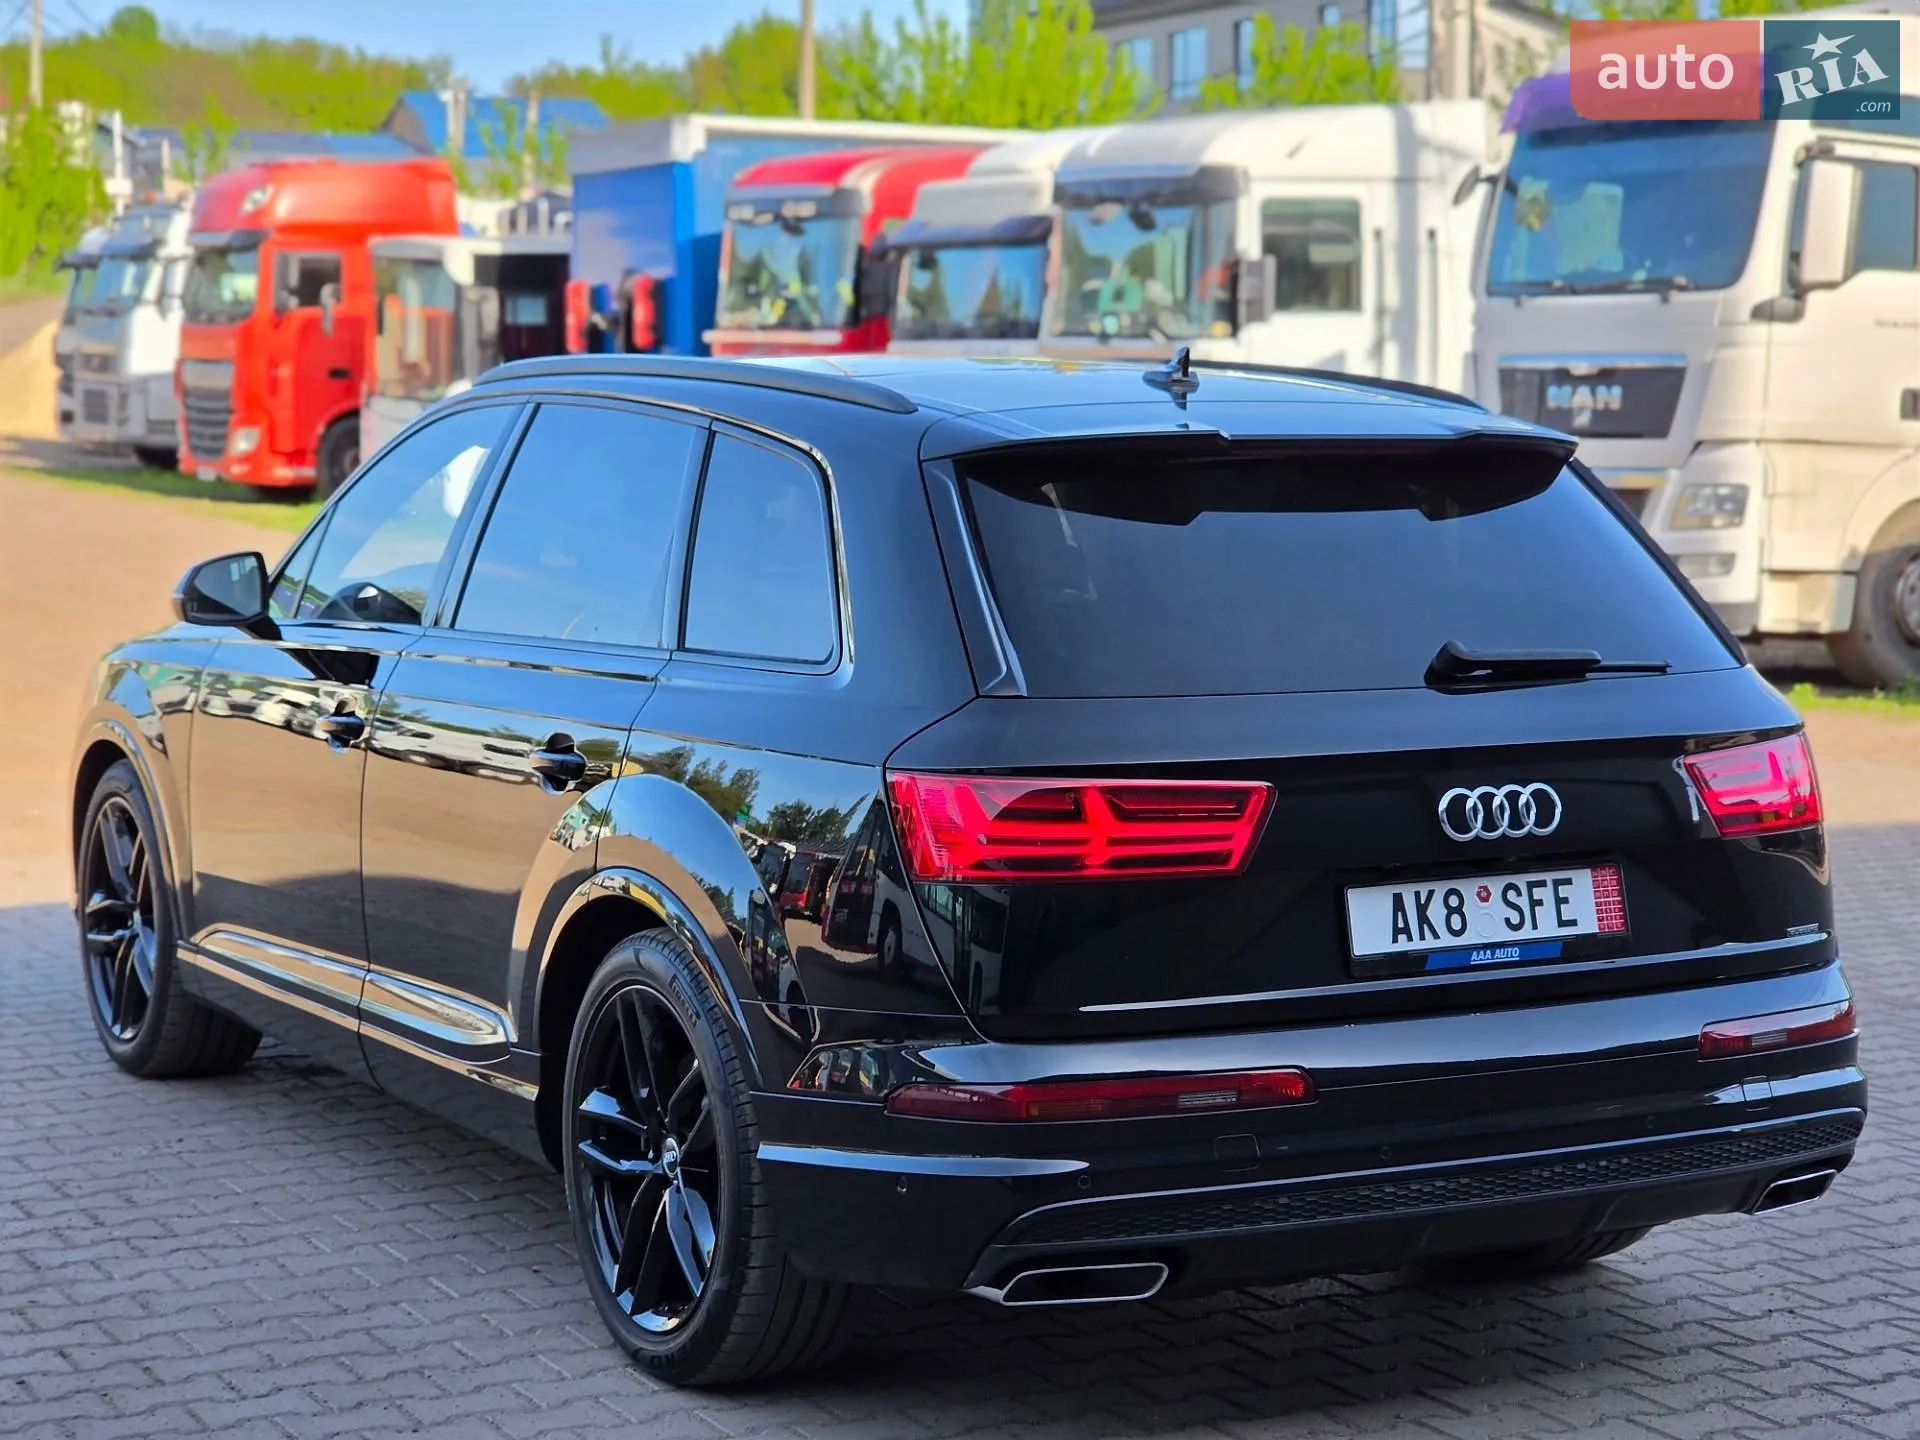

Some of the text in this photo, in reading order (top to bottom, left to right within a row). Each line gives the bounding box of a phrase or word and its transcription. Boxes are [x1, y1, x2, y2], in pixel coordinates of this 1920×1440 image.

[1546, 384, 1622, 411] MAN
[1391, 887, 1468, 944] AK8
[1501, 877, 1578, 932] SFE
[1470, 946, 1520, 961] AAA AUTO
